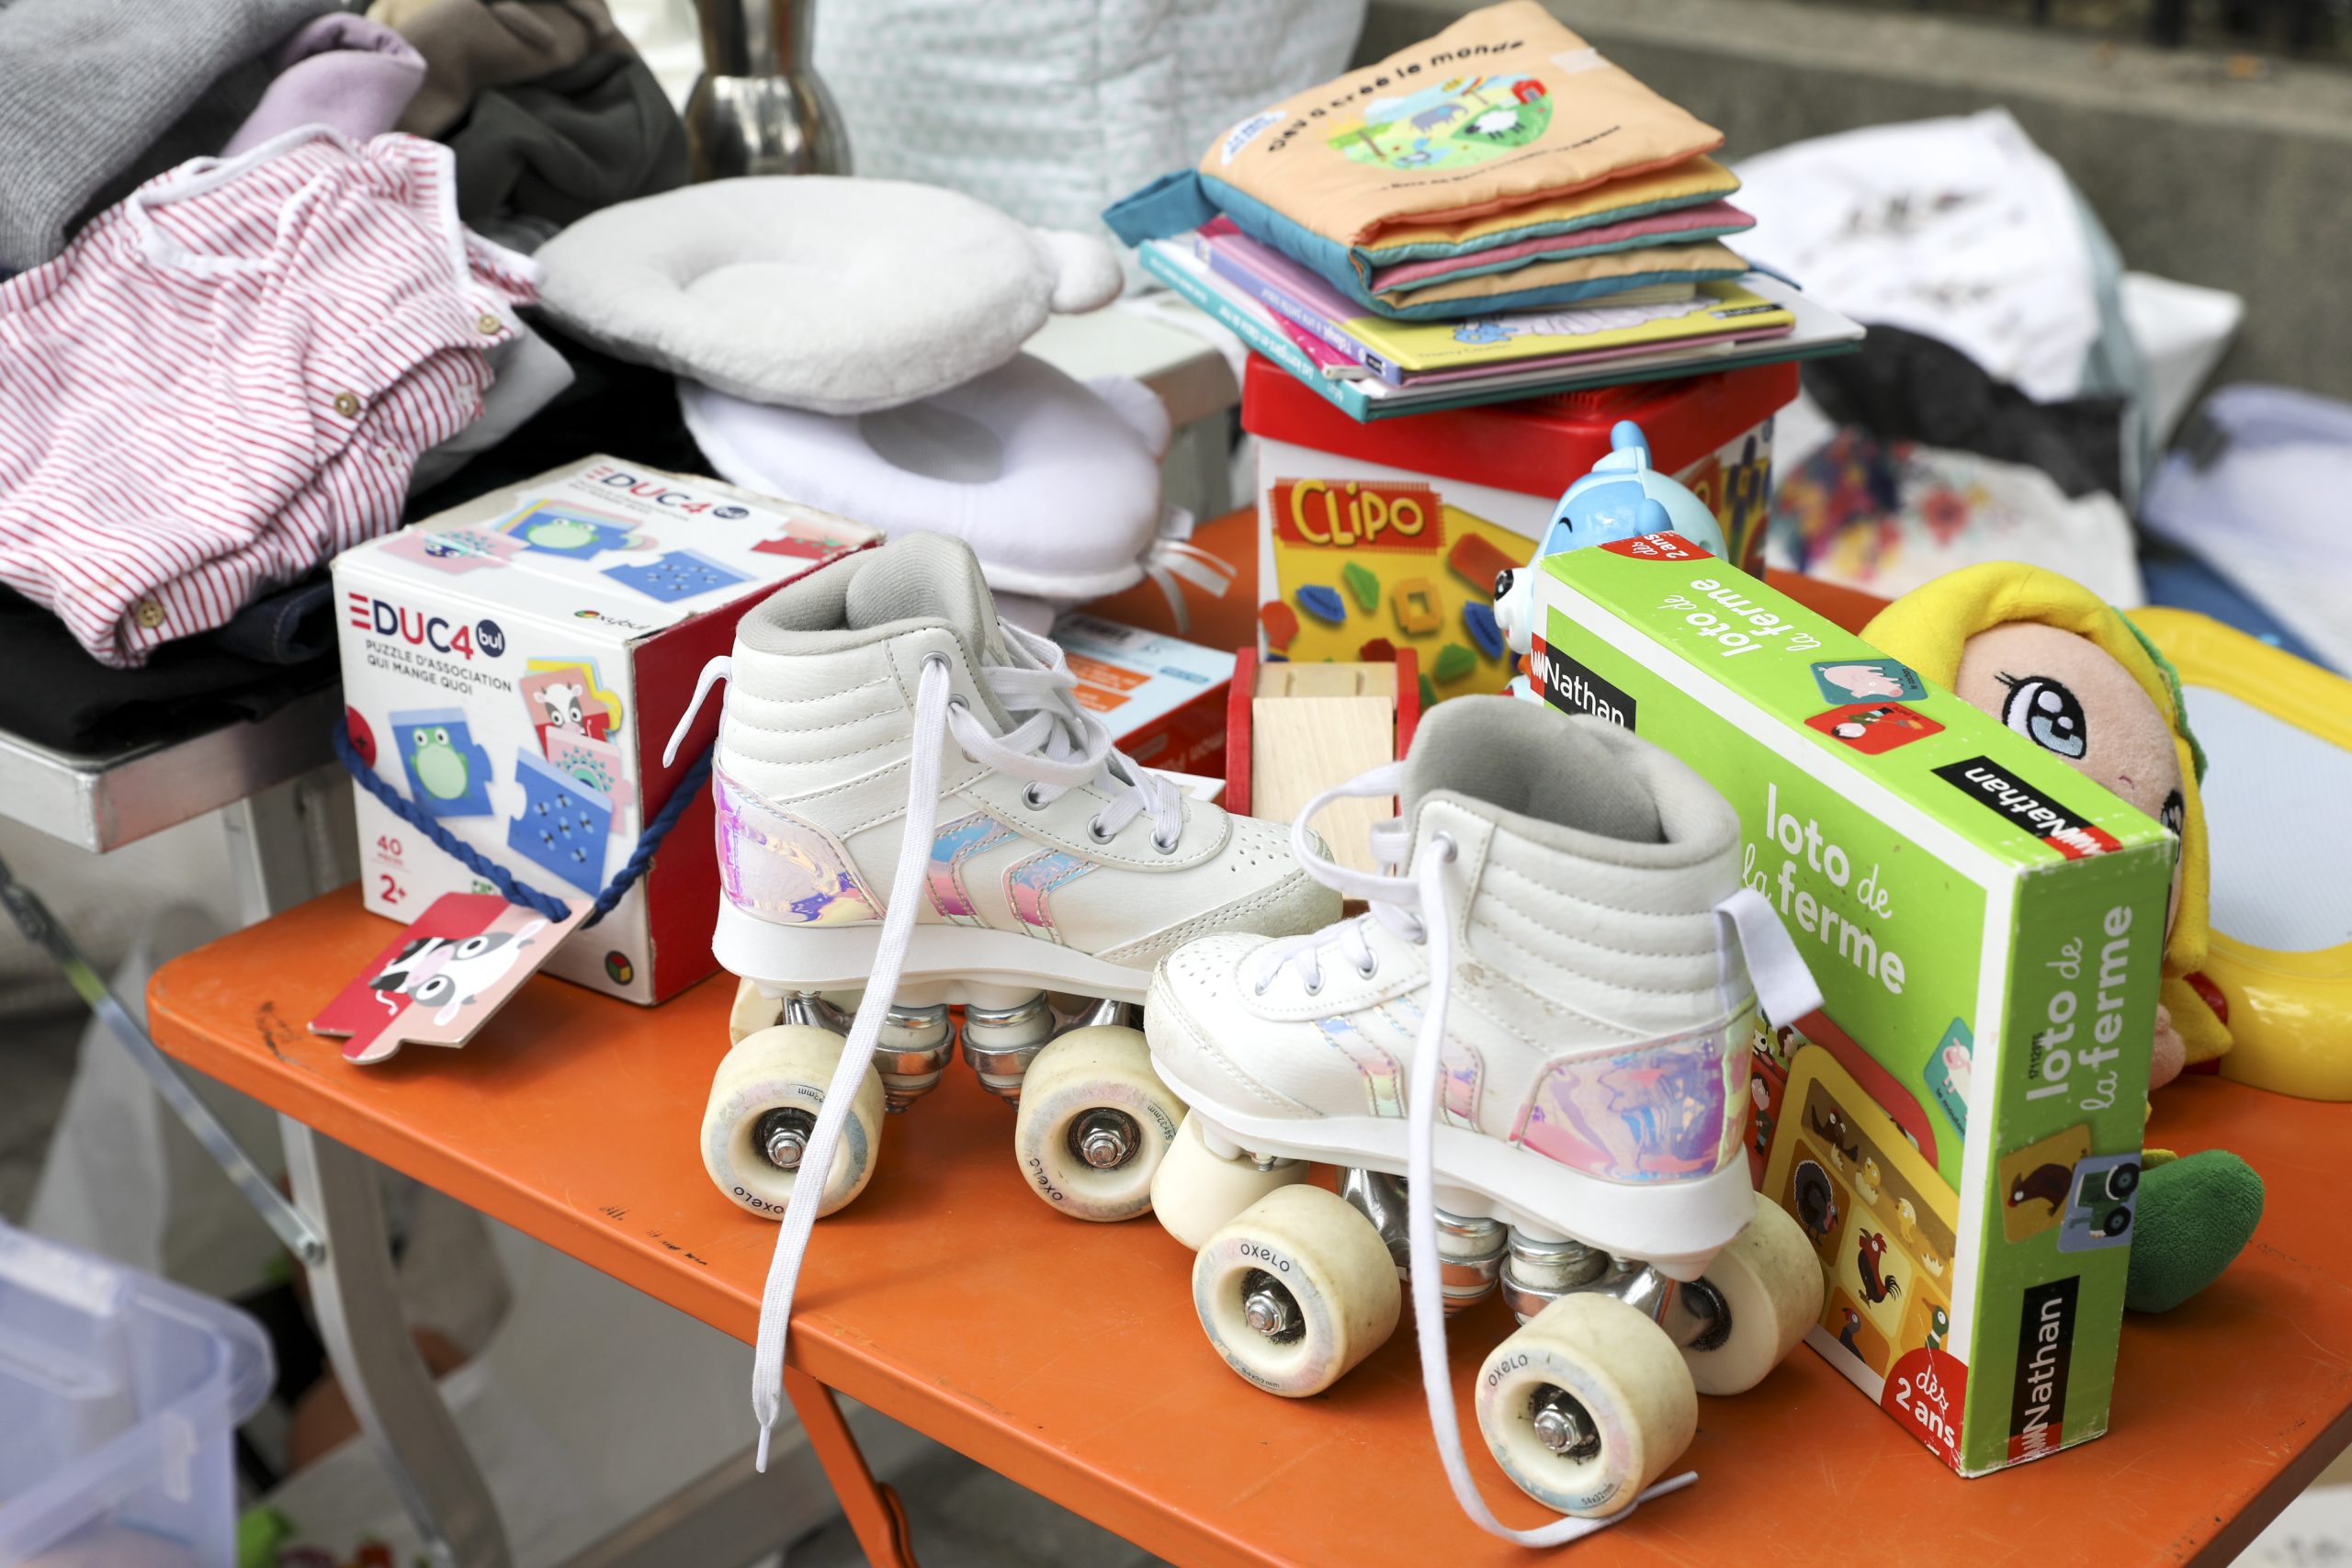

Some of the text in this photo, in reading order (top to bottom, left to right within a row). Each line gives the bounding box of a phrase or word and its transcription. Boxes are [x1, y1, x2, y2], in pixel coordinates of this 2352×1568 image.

[1396, 63, 1421, 79] le
[586, 465, 713, 513] EDUC4
[1290, 478, 1424, 547] CLiPO
[1643, 534, 1690, 558] 2 ans
[349, 592, 503, 660] EDUC4 bul
[1657, 594, 1763, 657] loto de
[1690, 578, 1822, 651] la ferme
[366, 638, 512, 693] PUZZLE D'ASSOCIATION
[367, 654, 473, 695] QUI MANGE QUOI
[1544, 655, 1624, 728] Nathan
[1964, 767, 2069, 838] Nathan
[377, 836, 403, 857] 40
[1765, 783, 1893, 919] loto de
[379, 874, 407, 904] 2+
[1743, 843, 1905, 995] la ferme
[2026, 936, 2083, 1100] loto de
[2077, 905, 2132, 1111] la ferme
[1916, 1364, 1950, 1411] dès
[2022, 1297, 2064, 1434] Nathan
[1895, 1376, 1955, 1450] 2 ans
